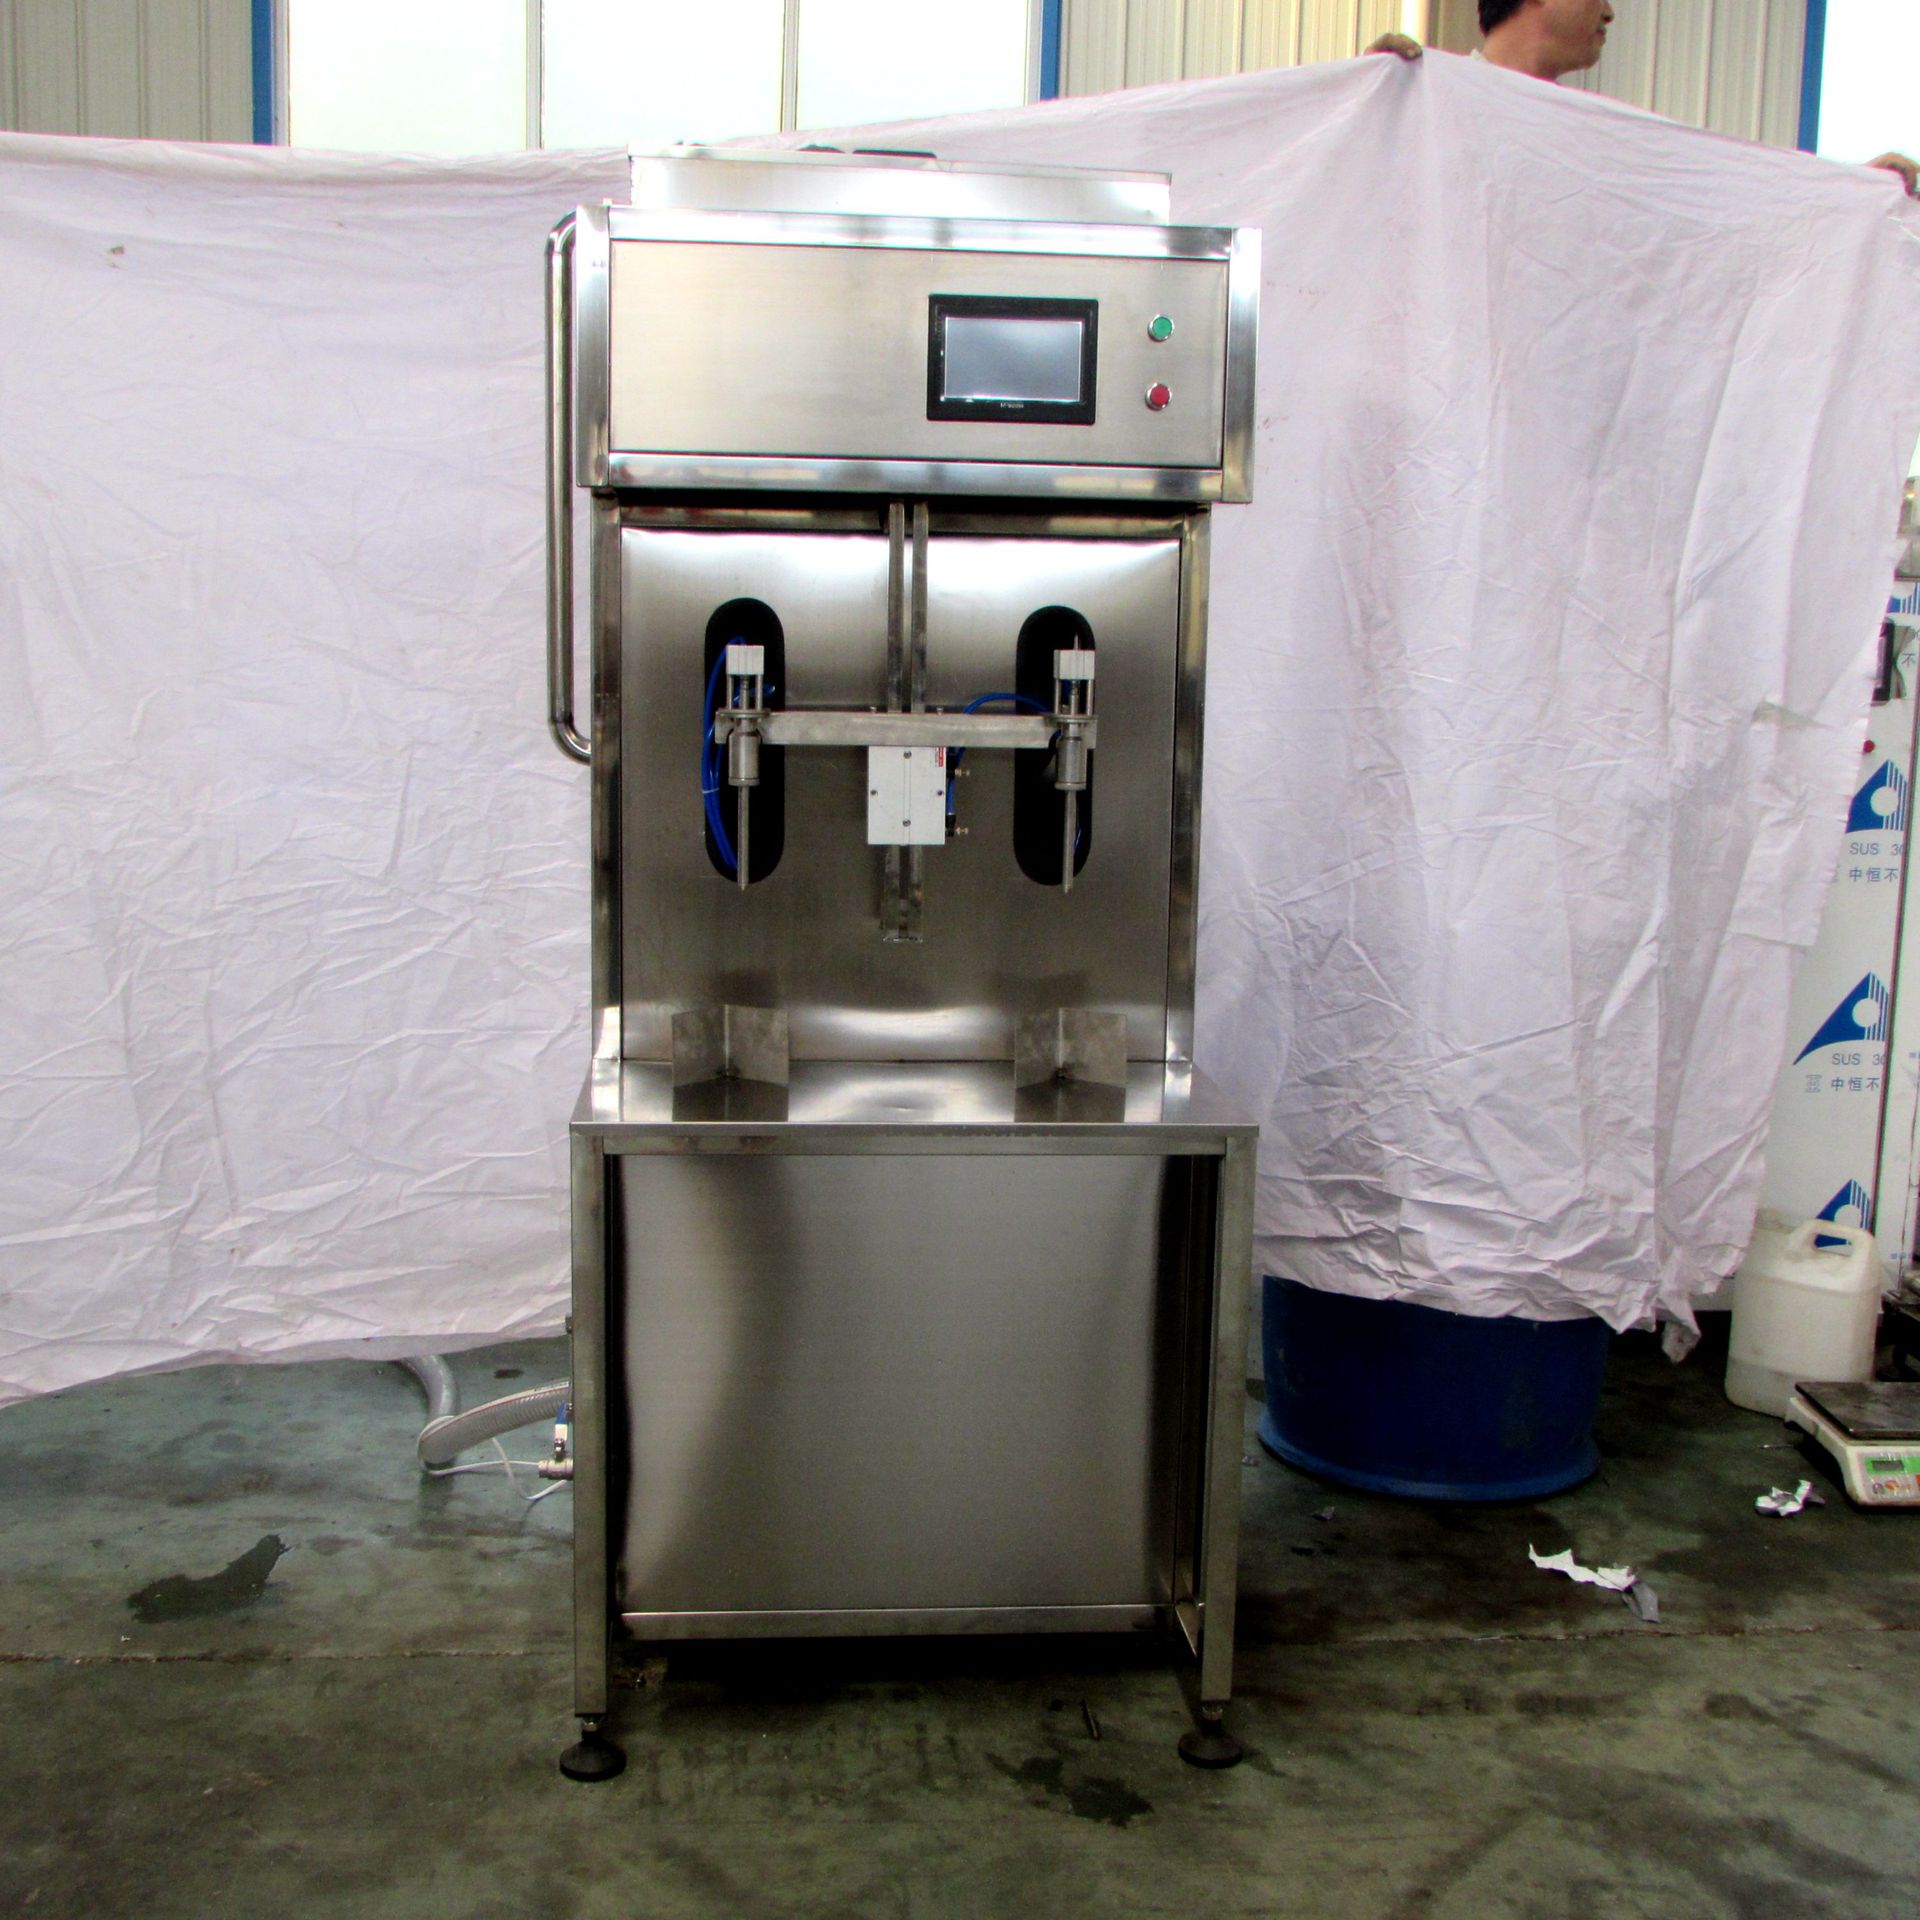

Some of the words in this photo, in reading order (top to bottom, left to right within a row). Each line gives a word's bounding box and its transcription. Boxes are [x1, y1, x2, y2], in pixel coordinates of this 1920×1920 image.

[1849, 842, 1880, 855] SUS
[1849, 866, 1899, 882] 中恒不
[1832, 1052, 1861, 1066] SUS
[1831, 1076, 1880, 1092] 中恒不
